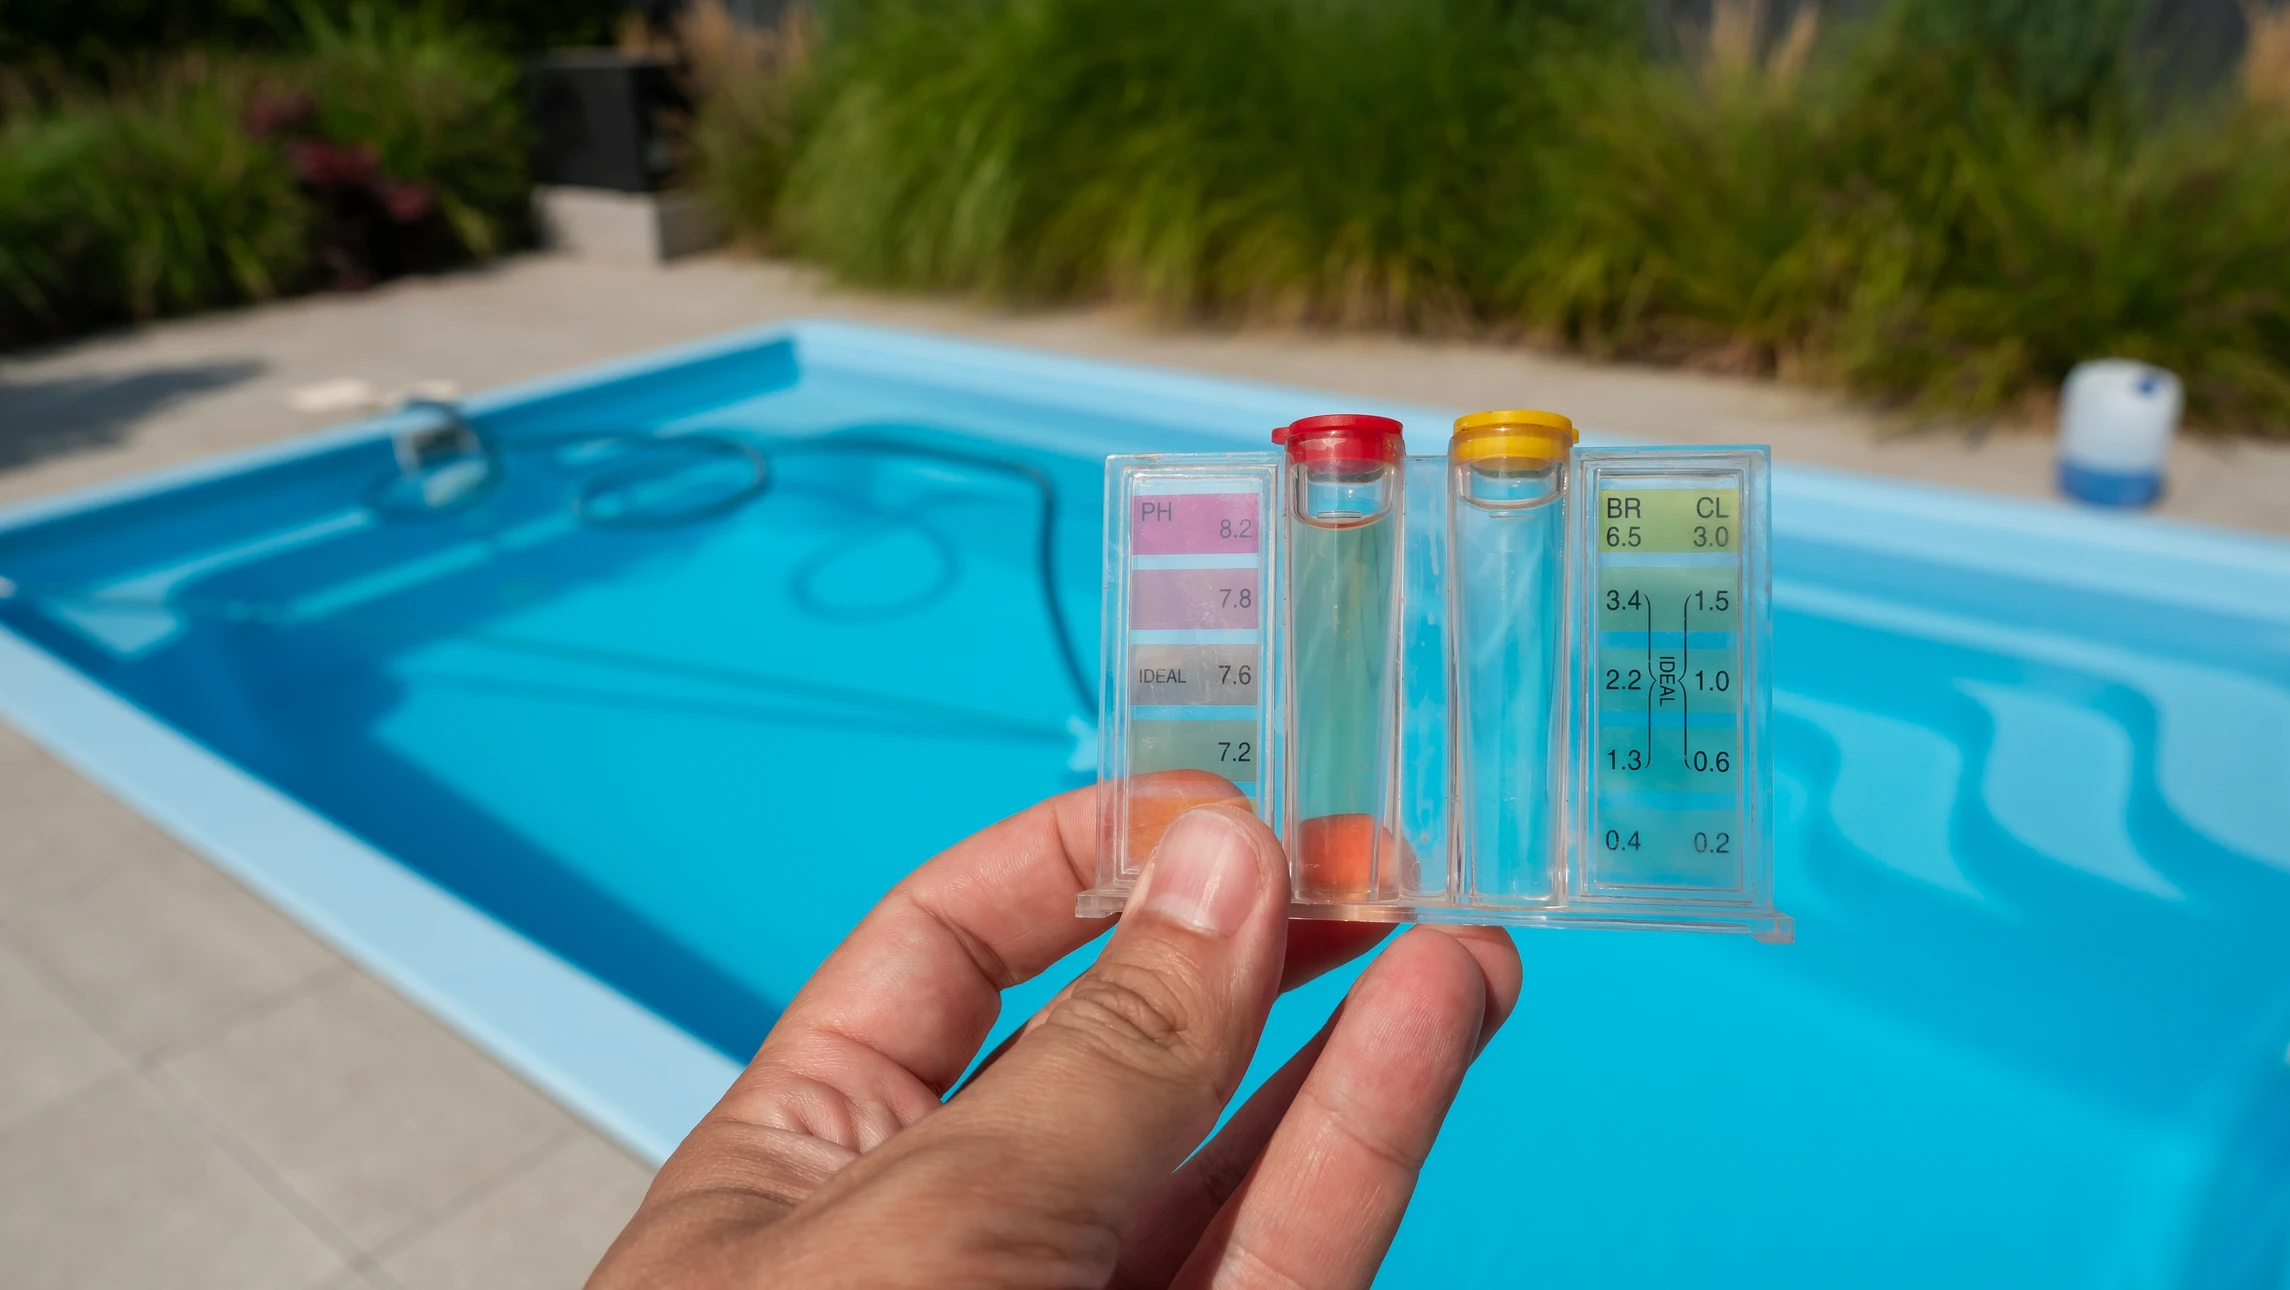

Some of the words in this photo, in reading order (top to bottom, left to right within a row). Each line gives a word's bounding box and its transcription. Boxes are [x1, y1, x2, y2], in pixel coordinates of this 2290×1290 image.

[1141, 501, 1172, 522] PH
[1606, 497, 1641, 519] BR
[1696, 497, 1729, 519] CL
[1219, 518, 1253, 540] 8.2
[1605, 526, 1642, 548] 6.5
[1693, 526, 1729, 548] 3.0
[1218, 588, 1252, 609] 7.8
[1605, 590, 1642, 611] 3.4
[1695, 590, 1729, 611] 1.5
[1138, 668, 1187, 684] IDEAL
[1218, 665, 1252, 685] 7.6
[1605, 669, 1642, 690] 2.2
[1659, 655, 1676, 707] IDEAL
[1695, 670, 1730, 692] 1.0
[1218, 742, 1252, 762] 7.2
[1607, 749, 1642, 771] 1.3
[1693, 751, 1730, 772] 0.6
[1605, 829, 1641, 851] 0.4
[1693, 832, 1730, 854] 0.2
